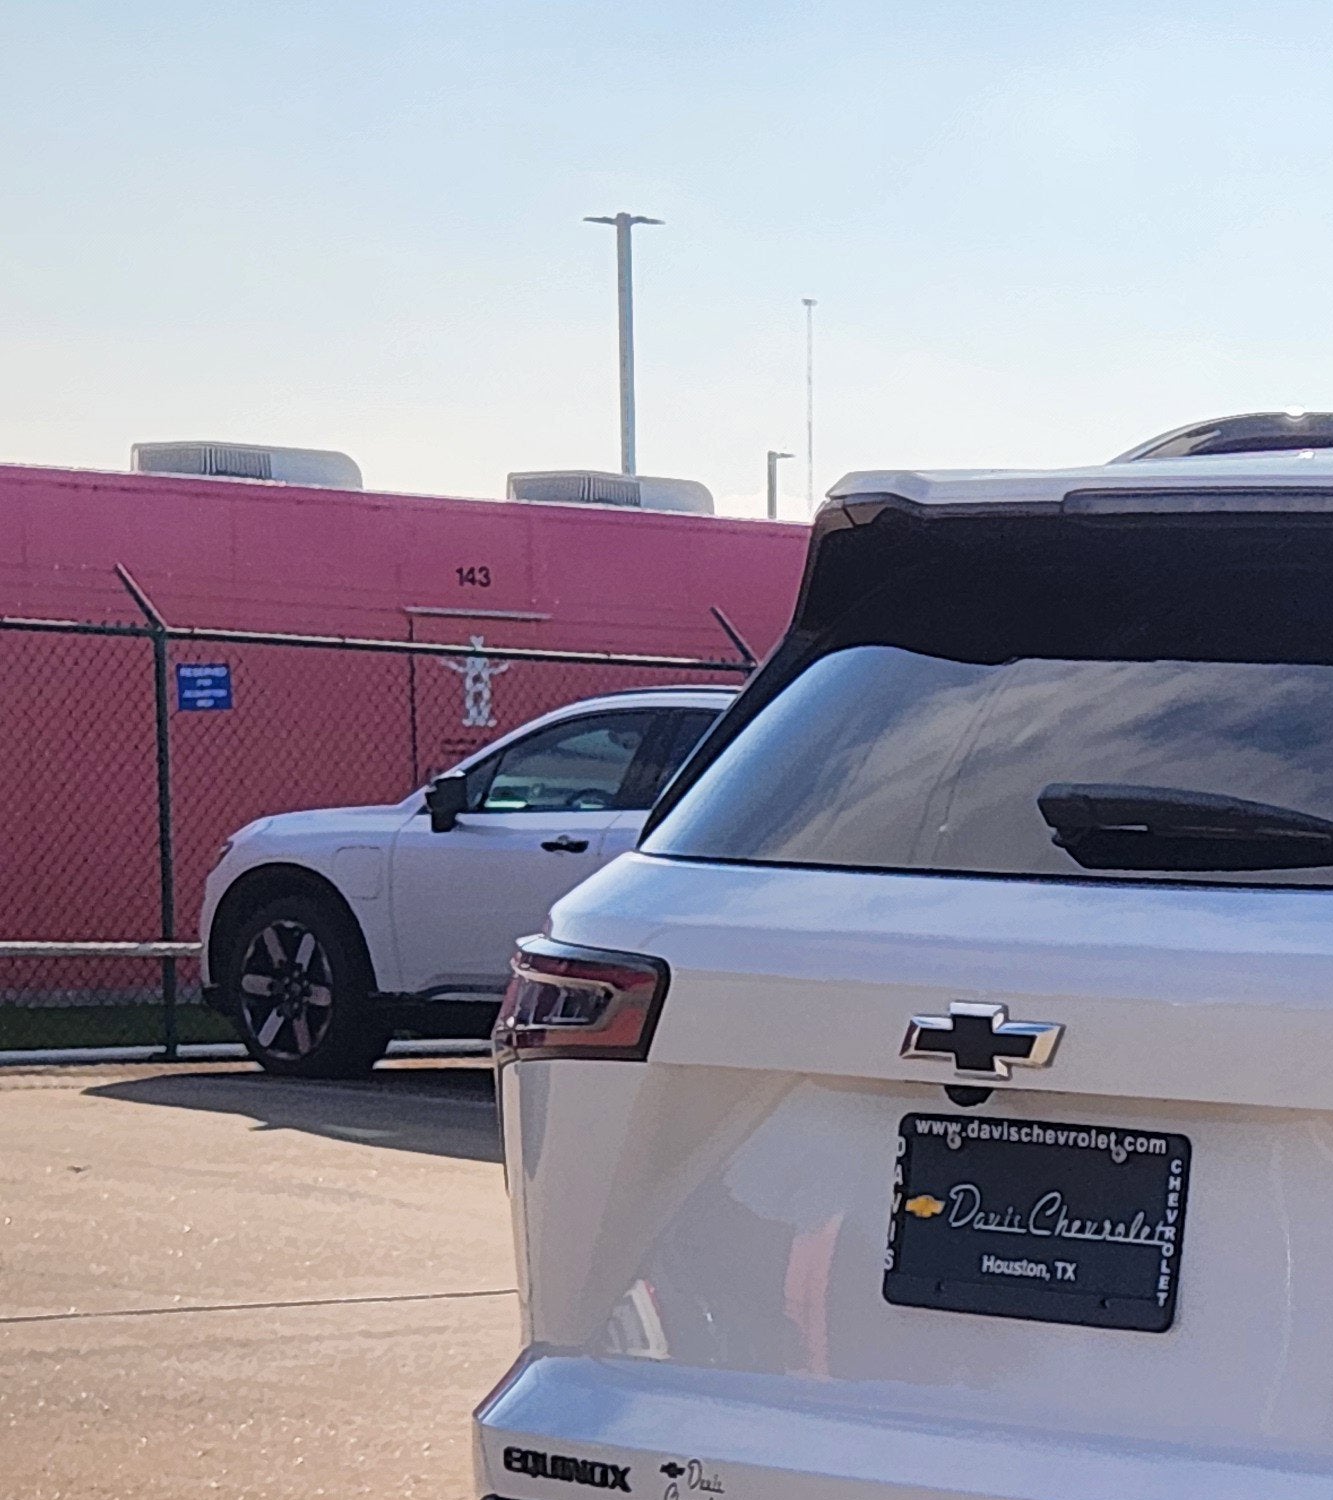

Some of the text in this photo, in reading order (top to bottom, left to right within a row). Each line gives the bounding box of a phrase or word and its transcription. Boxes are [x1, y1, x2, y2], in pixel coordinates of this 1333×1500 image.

[455, 566, 491, 587] 143
[915, 1119, 1167, 1154] www.davischevrolet.com
[1156, 1159, 1182, 1307] CHEVROLET
[981, 1254, 1077, 1281] Houston, TX
[503, 1446, 632, 1493] EQUINOX
